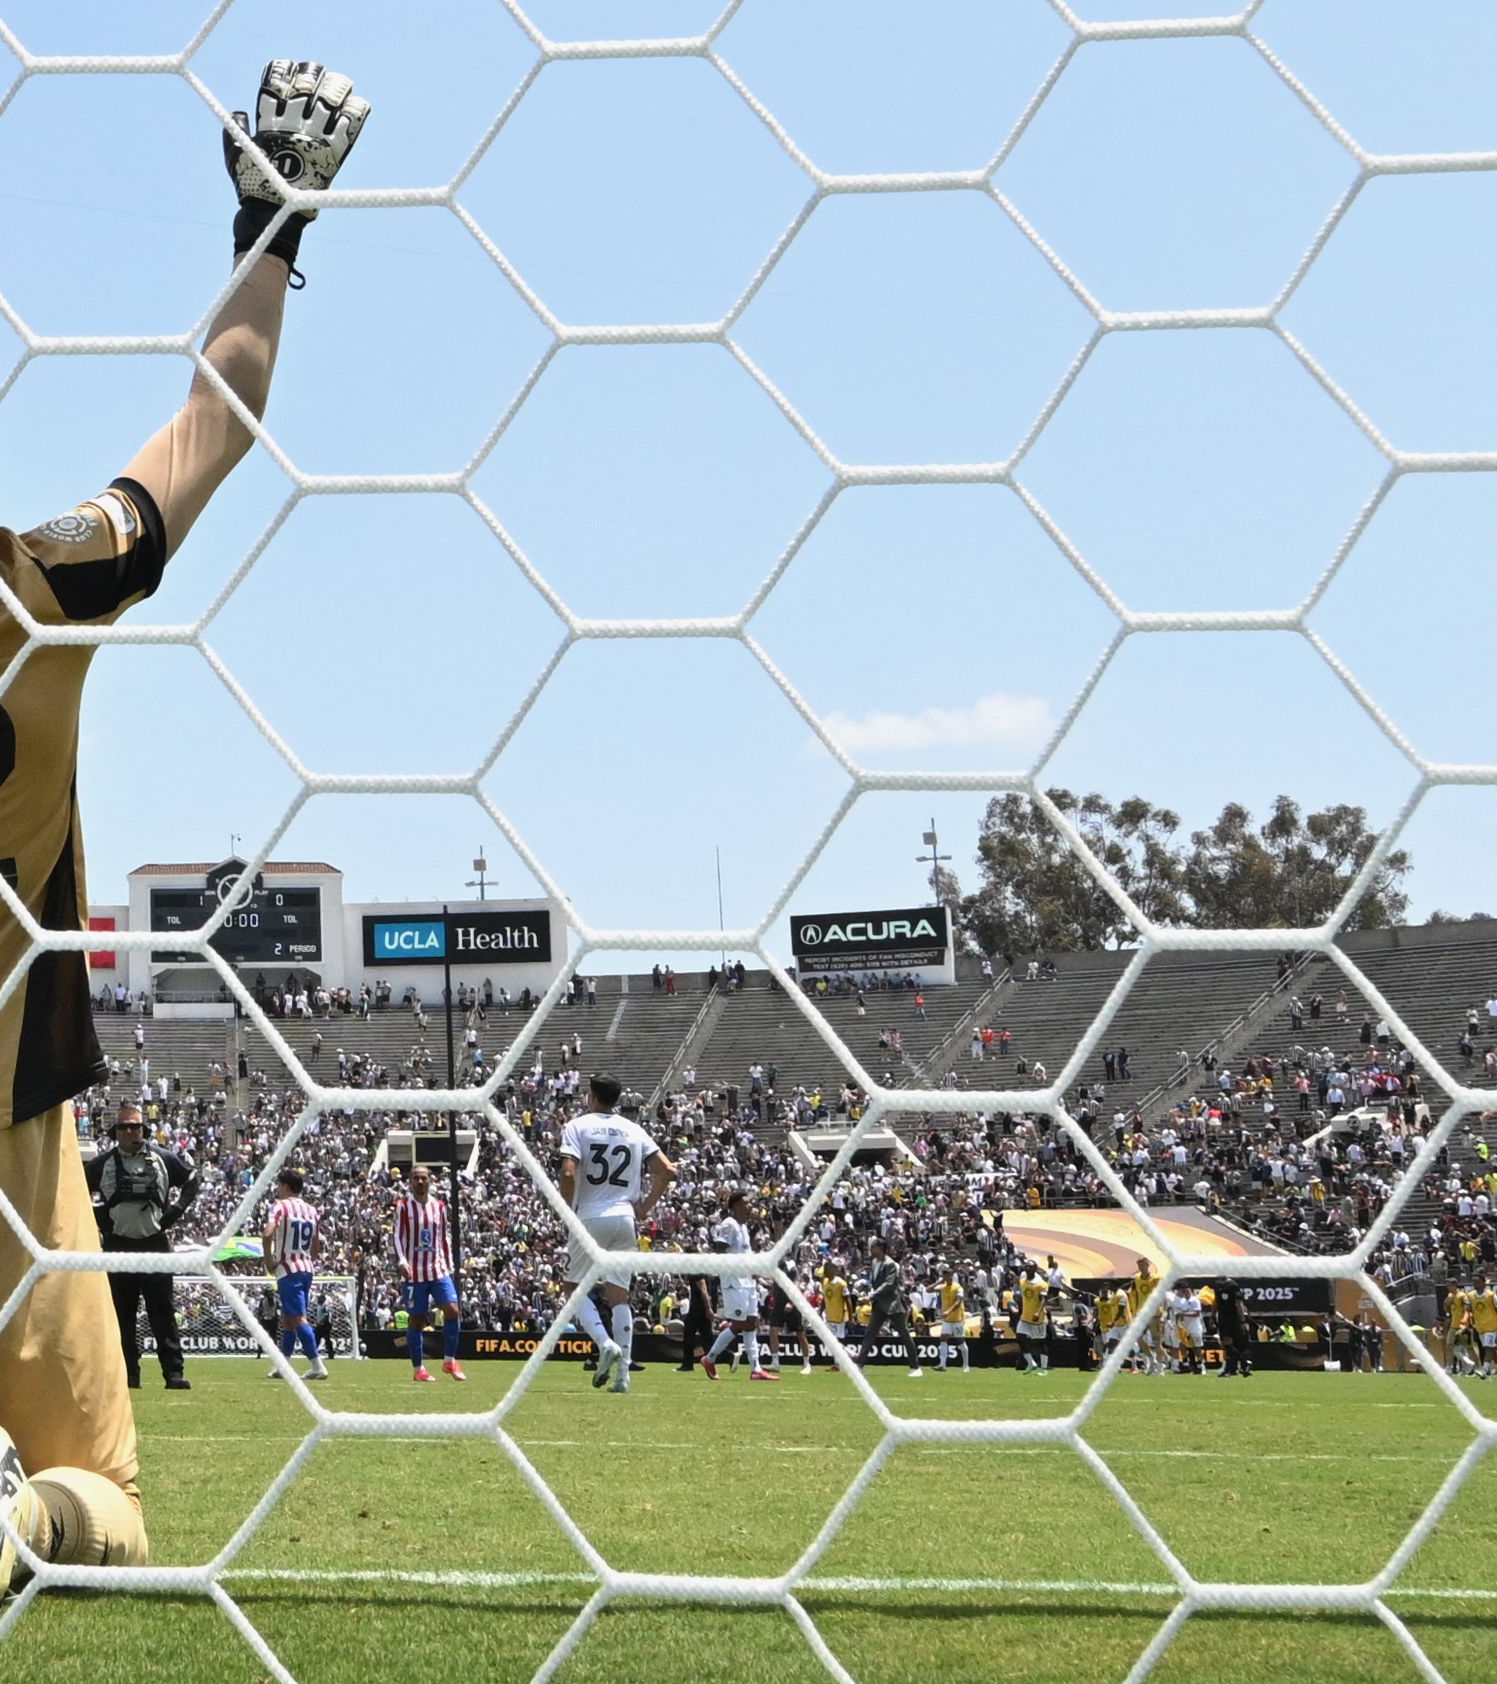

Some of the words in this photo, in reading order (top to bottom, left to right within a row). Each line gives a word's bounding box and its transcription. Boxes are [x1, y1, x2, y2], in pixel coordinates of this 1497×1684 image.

[275, 894, 284, 906] 0
[384, 930, 440, 950] UCLA
[456, 926, 539, 950] Health
[823, 919, 938, 943] ACURA
[274, 943, 282, 955] 2
[289, 944, 317, 954] PERIOD
[586, 1143, 631, 1188] 32
[291, 1220, 314, 1251] 19
[406, 1285, 415, 1299] 7
[179, 1336, 219, 1350] CLUB
[222, 1336, 259, 1350] WOR
[737, 1343, 772, 1357] FFA
[819, 1343, 878, 1357] WRD
[880, 1344, 909, 1358] CU
[917, 1344, 958, 1358] 205
